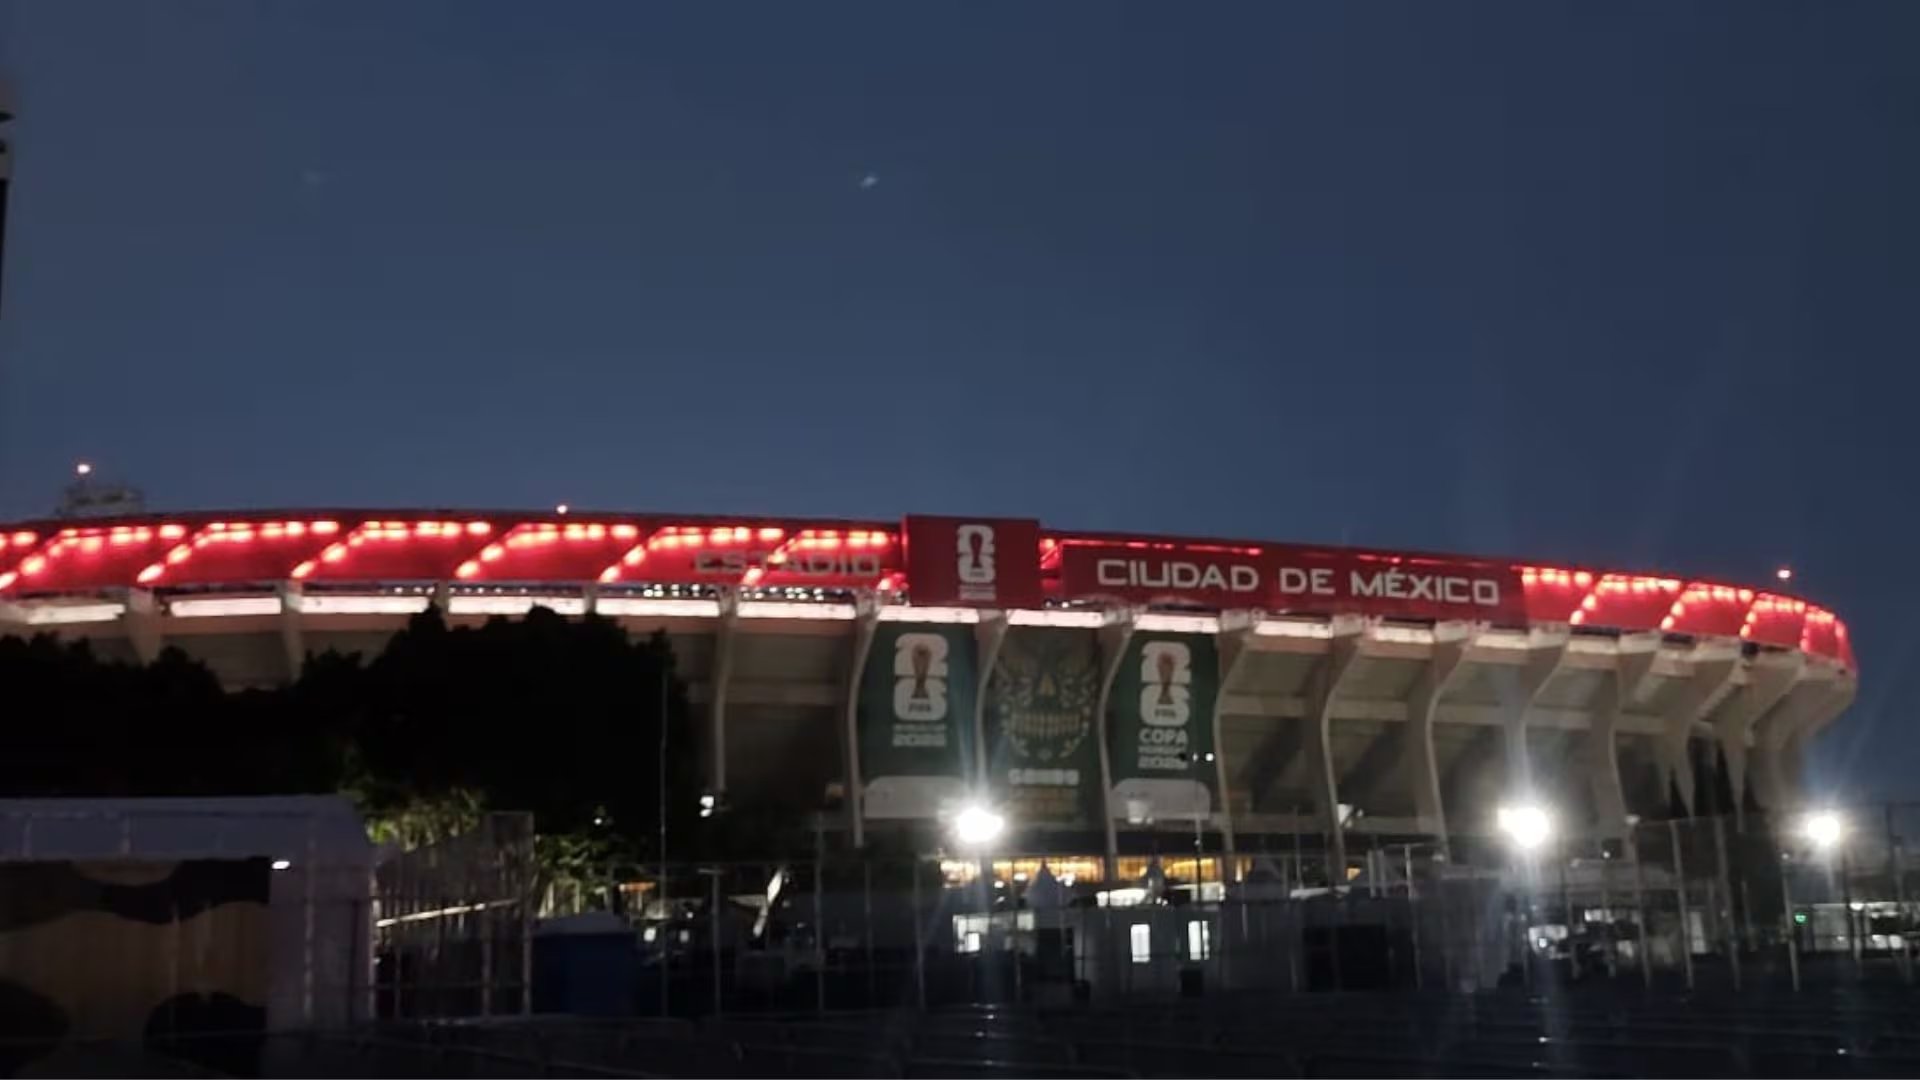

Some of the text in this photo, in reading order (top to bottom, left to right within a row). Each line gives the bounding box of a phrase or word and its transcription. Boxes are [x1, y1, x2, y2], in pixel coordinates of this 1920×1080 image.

[1096, 559, 1500, 606] CIUDAD DE MÉXICO
[1138, 728, 1189, 745] COPA
